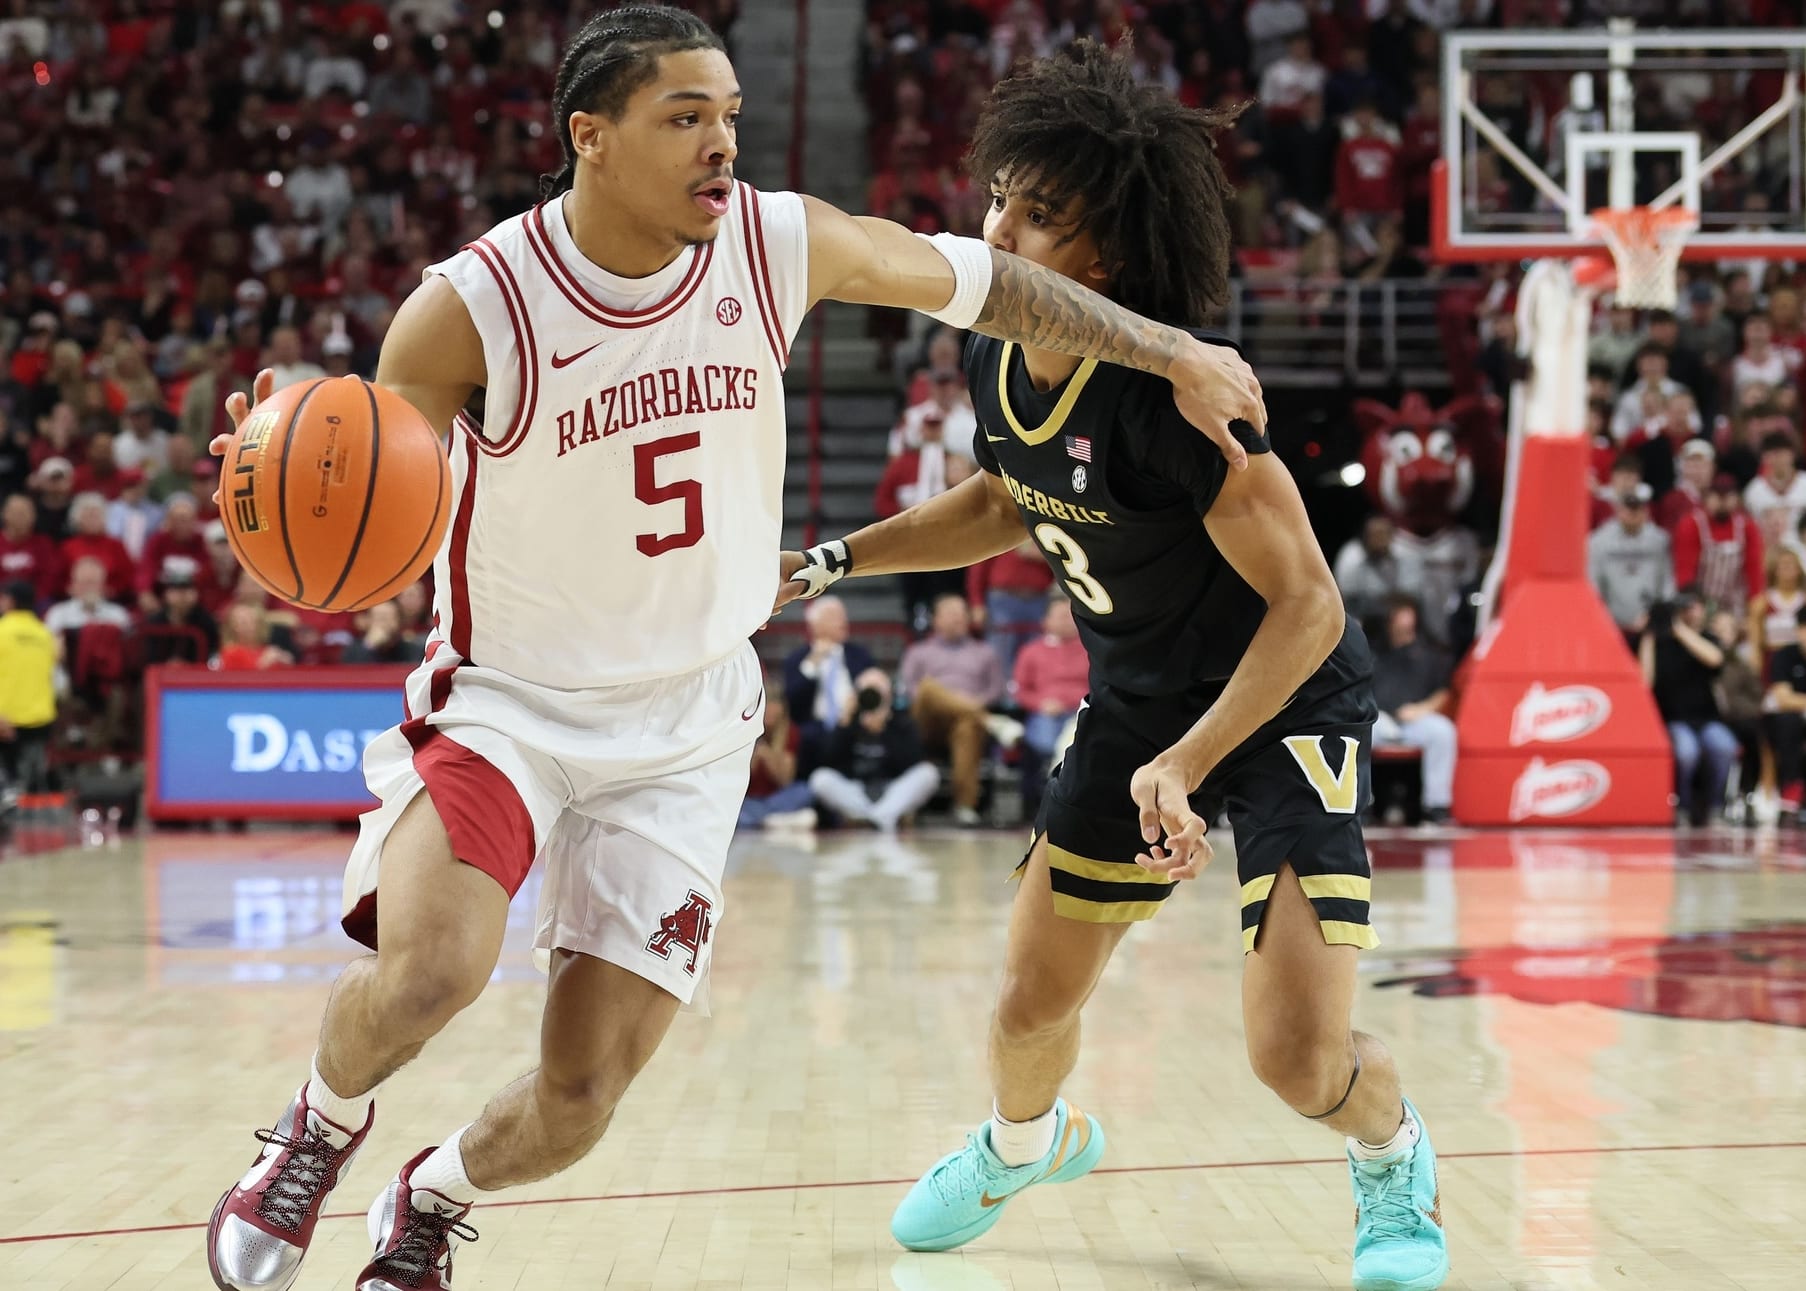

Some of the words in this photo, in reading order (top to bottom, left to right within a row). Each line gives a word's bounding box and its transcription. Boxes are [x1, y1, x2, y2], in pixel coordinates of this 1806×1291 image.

[717, 297, 742, 325] SEC
[557, 365, 758, 457] RAZORBACKS
[234, 411, 270, 533] ELITE
[633, 431, 705, 557] 5
[998, 462, 1116, 525] NDERBILT
[1072, 465, 1088, 493] SEC
[1034, 522, 1113, 615] 3
[1280, 735, 1360, 814] V
[644, 888, 714, 977] A
